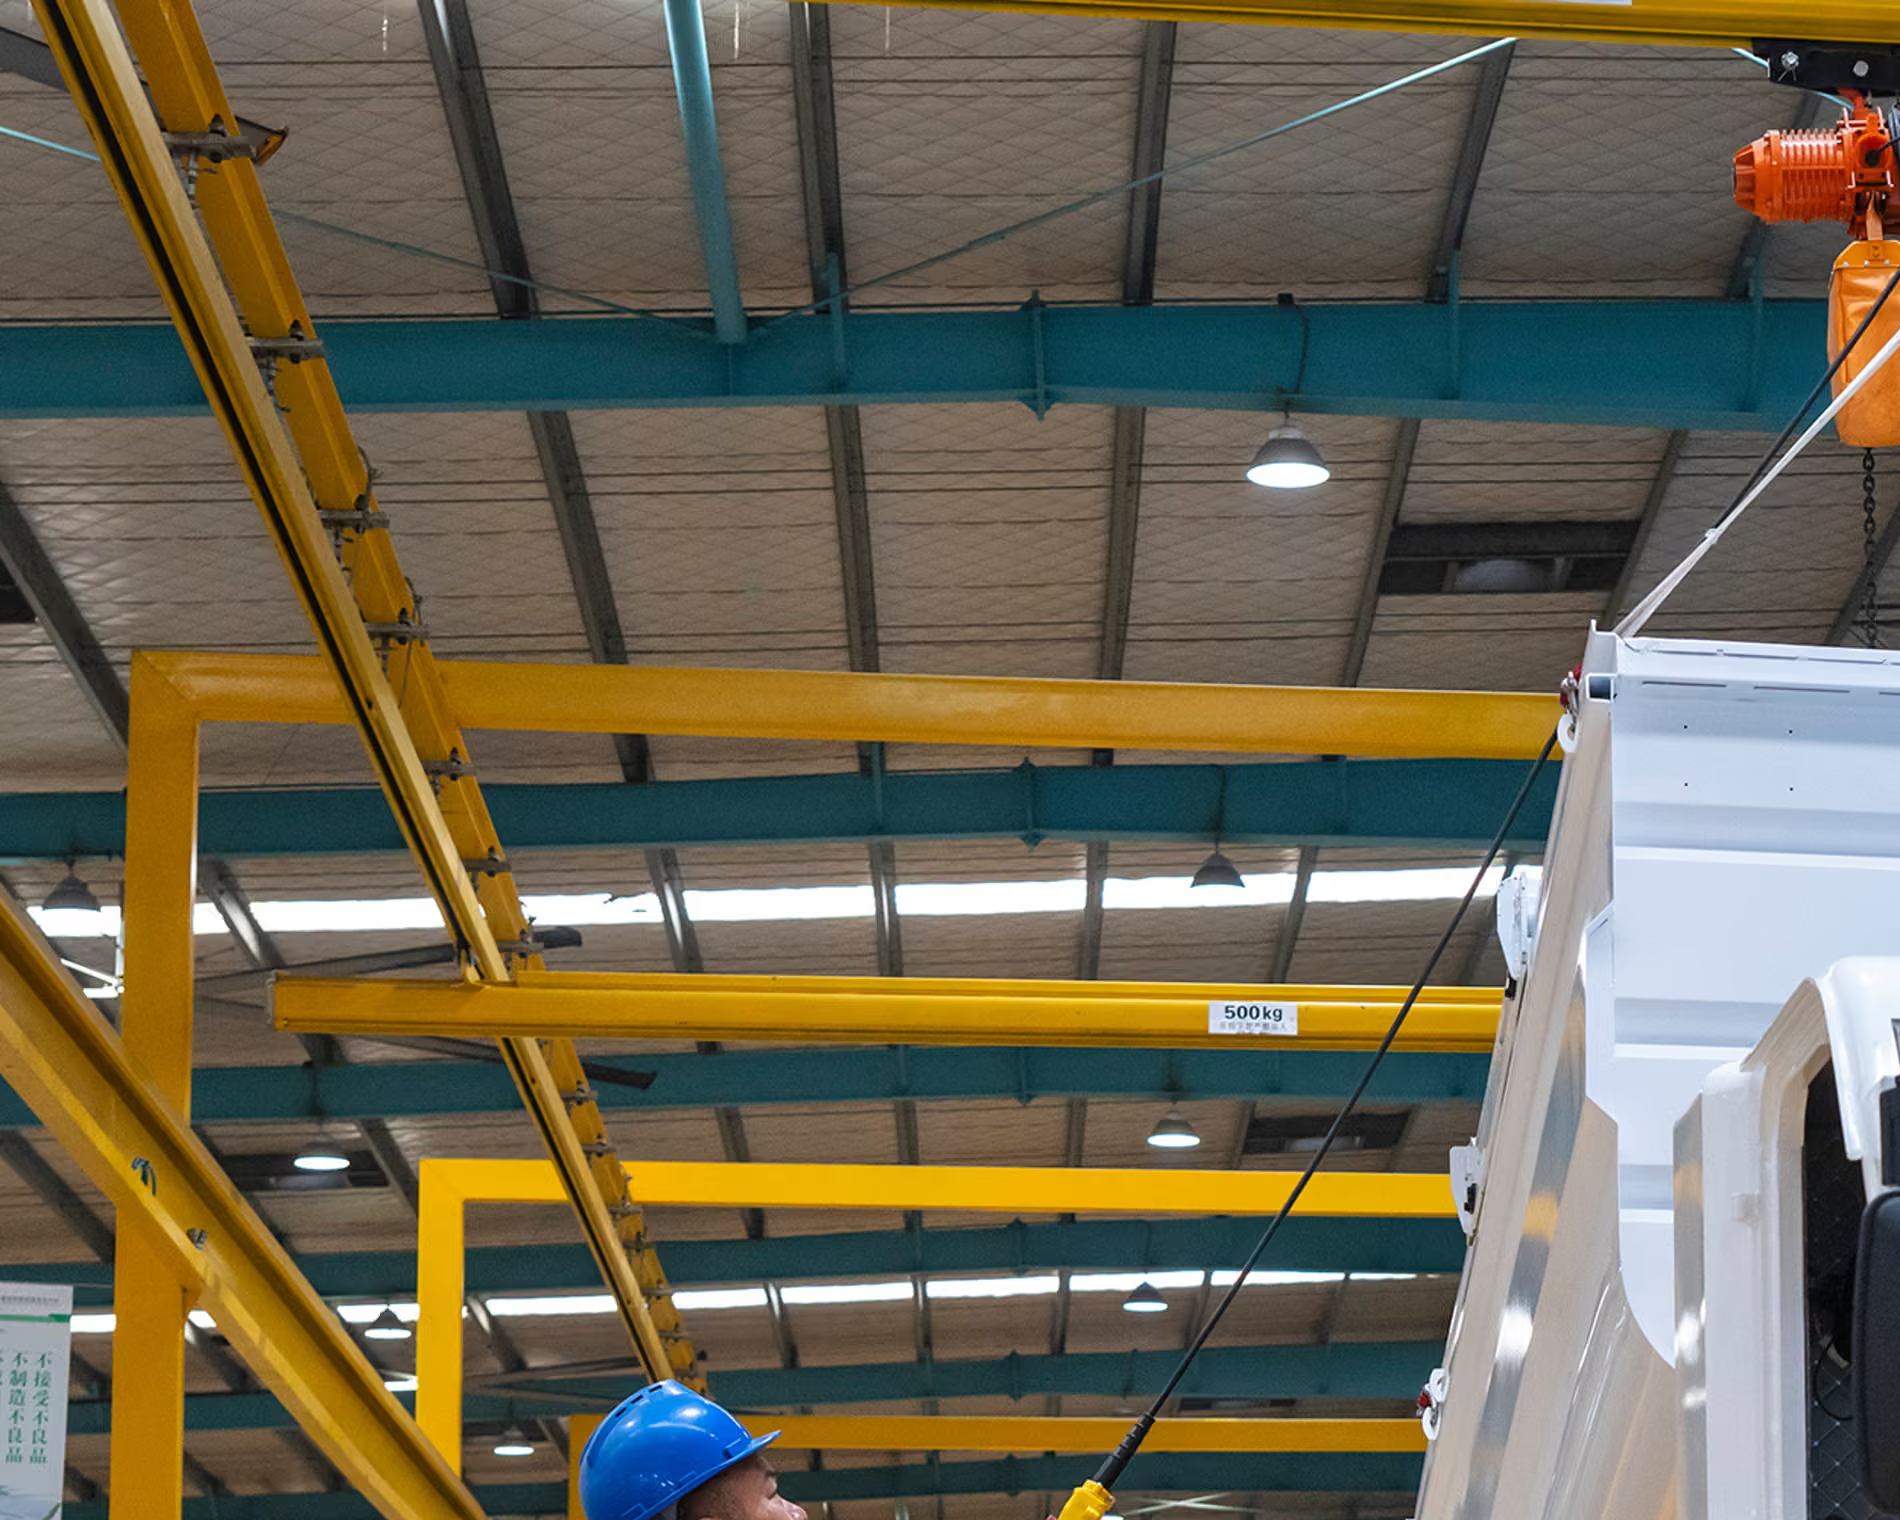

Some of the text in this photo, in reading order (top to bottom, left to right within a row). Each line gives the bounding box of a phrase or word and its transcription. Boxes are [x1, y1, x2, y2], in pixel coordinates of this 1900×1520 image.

[1225, 1005, 1282, 1022] 500kg
[5, 1352, 28, 1464] 不制造不良品
[30, 1353, 52, 1464] 不接受不良品
